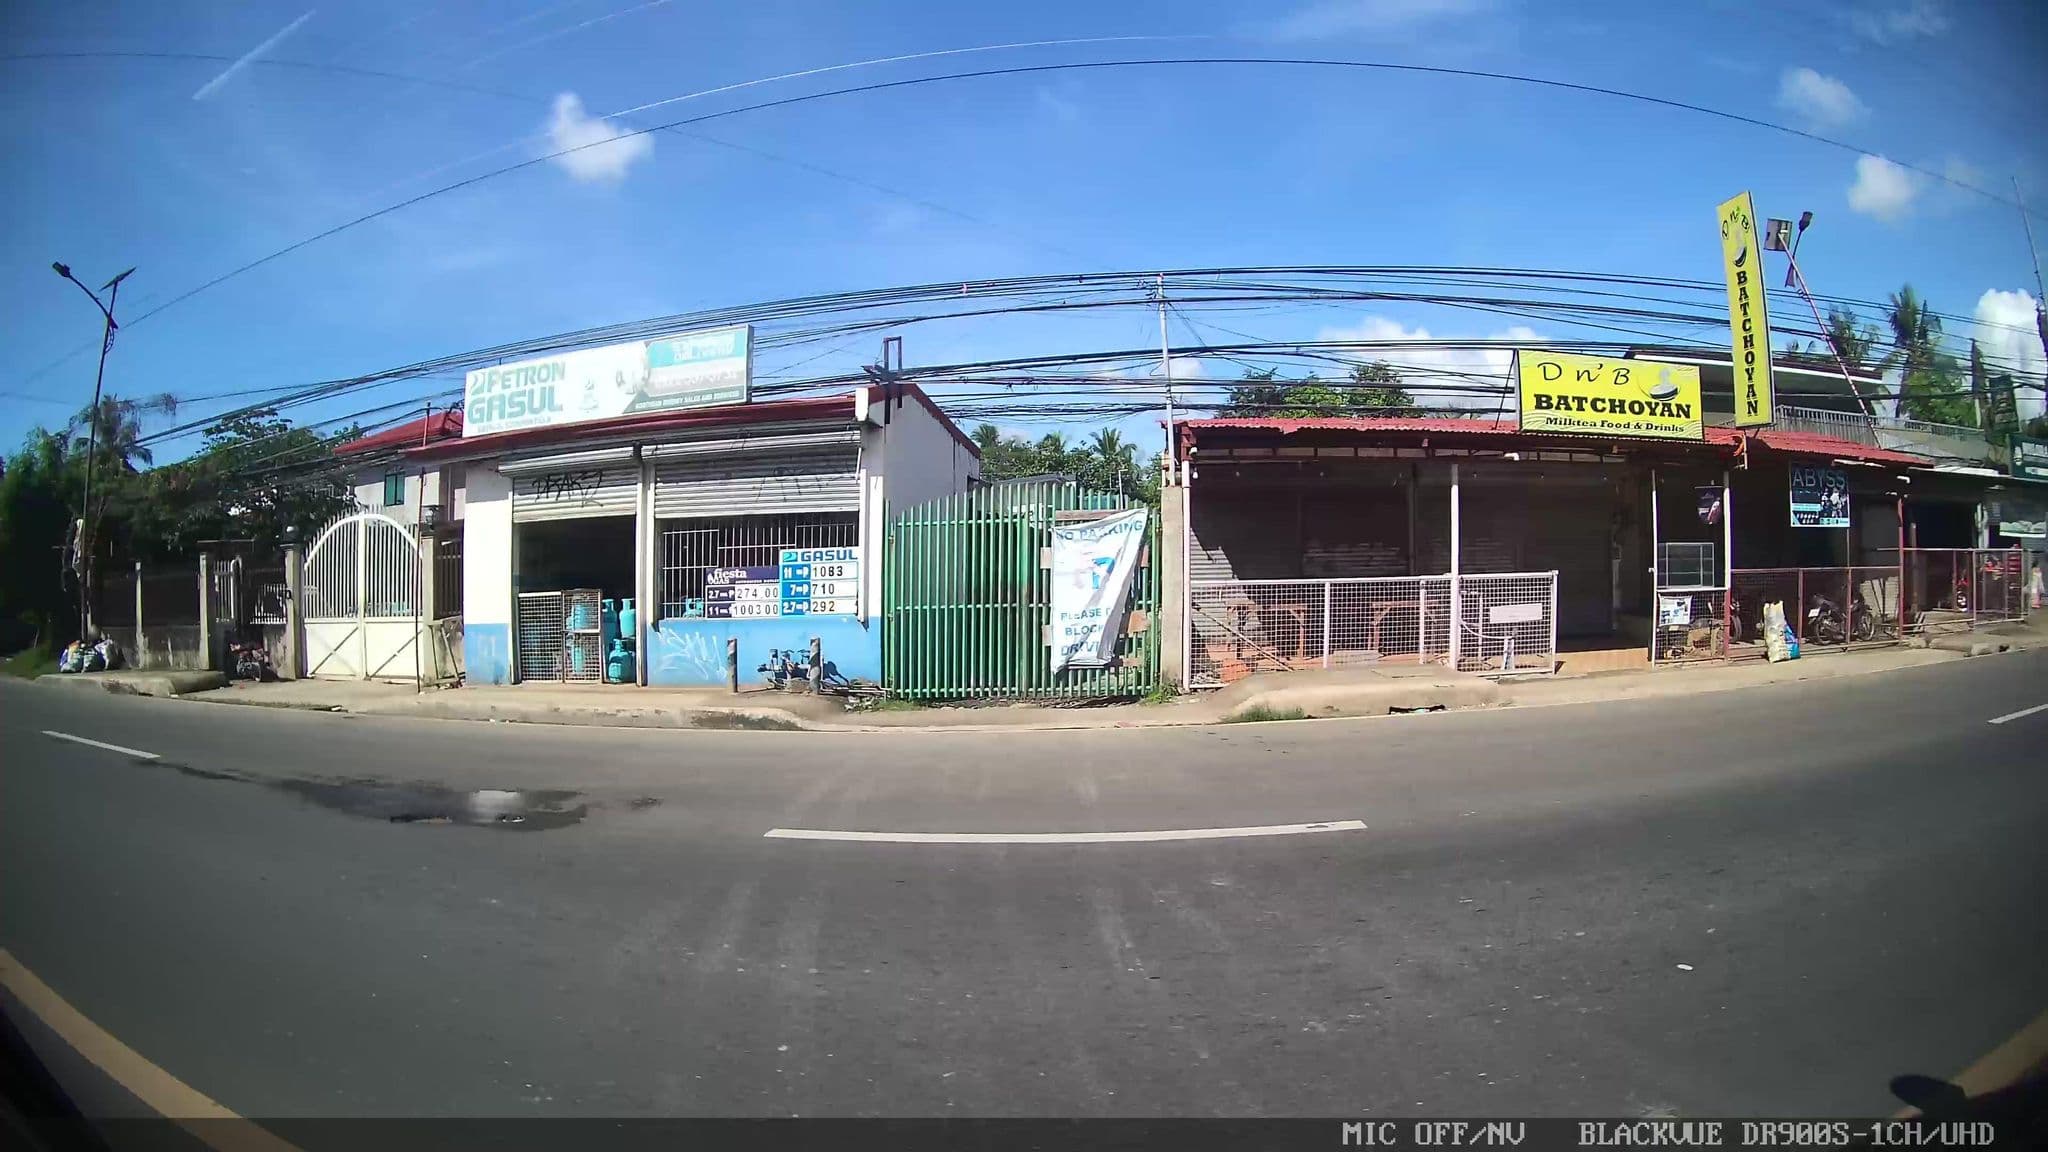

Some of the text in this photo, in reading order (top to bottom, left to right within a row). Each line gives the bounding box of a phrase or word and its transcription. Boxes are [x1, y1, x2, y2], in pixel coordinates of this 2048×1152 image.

[1736, 271, 1758, 416] BATCHOYAN
[487, 360, 567, 392] PETRON
[1537, 362, 1562, 381] D
[1612, 368, 1630, 385] B
[467, 385, 563, 424] GASUL
[1534, 393, 1691, 419] BATCHOYAN
[1545, 417, 1684, 432] Milktea Food & Drinks
[1792, 468, 1846, 489] ABYSS
[801, 549, 858, 562] GASUL
[714, 568, 747, 578] fiesta
[813, 565, 843, 578] 1083
[812, 583, 835, 595] 710
[813, 600, 835, 612] 292
[1061, 608, 1102, 620] PLEASE
